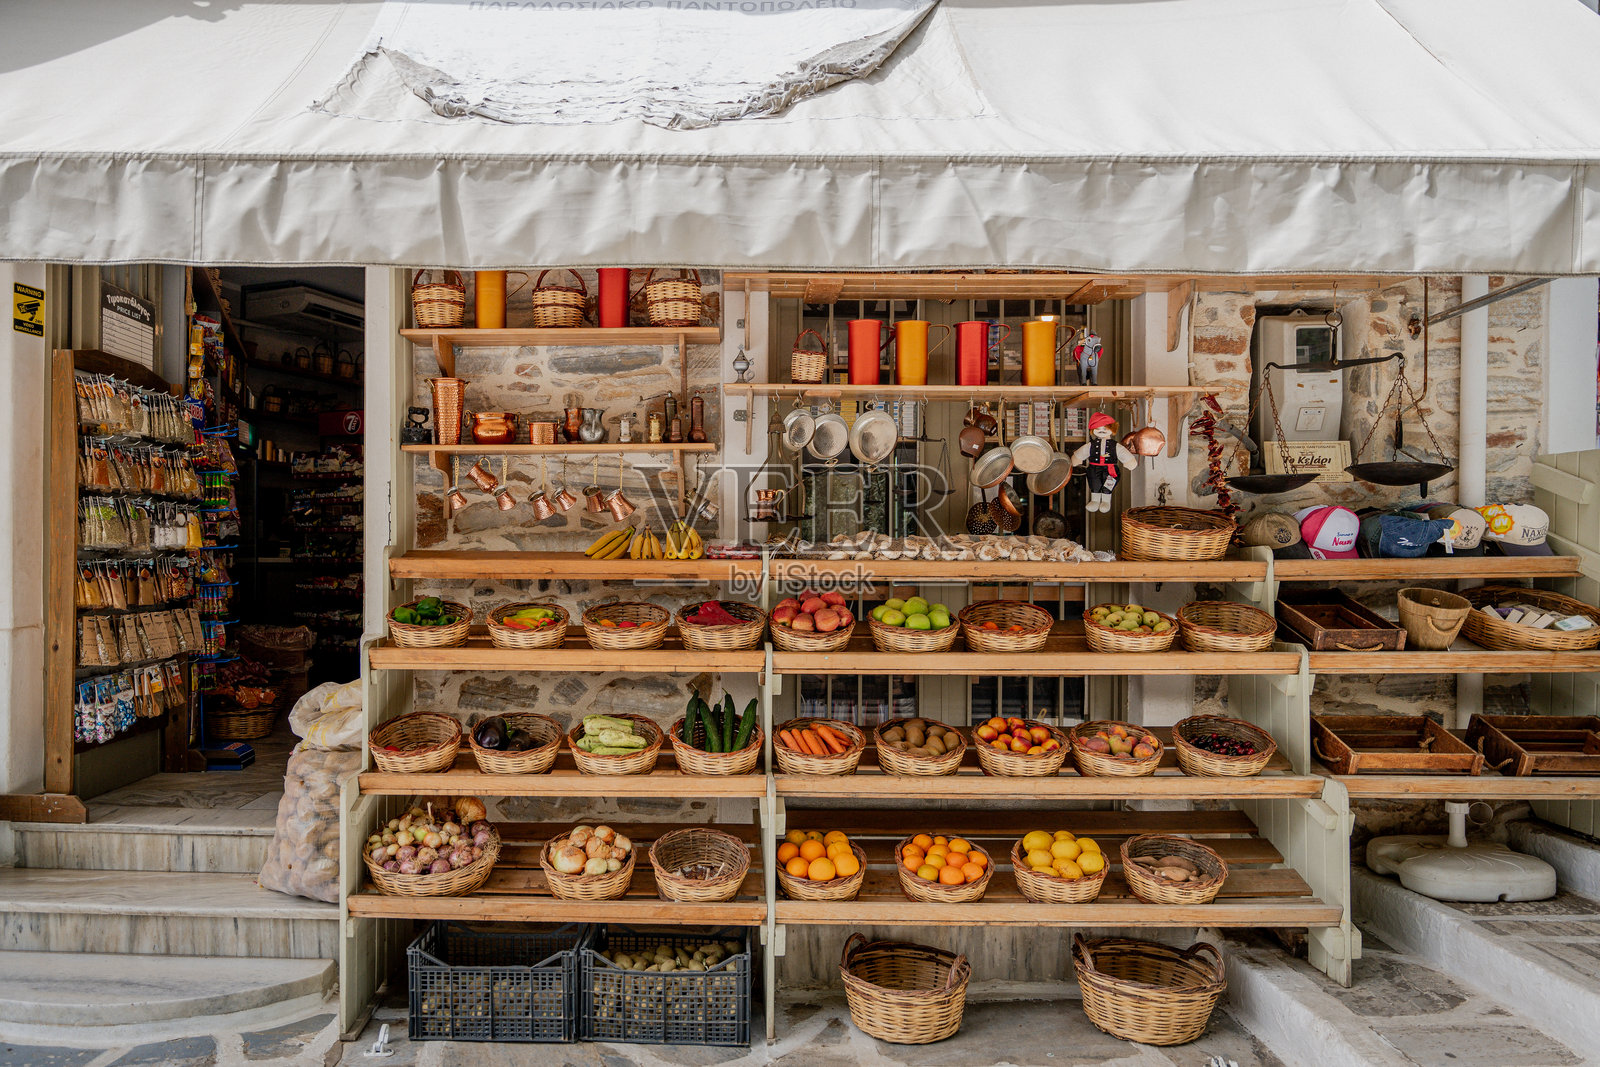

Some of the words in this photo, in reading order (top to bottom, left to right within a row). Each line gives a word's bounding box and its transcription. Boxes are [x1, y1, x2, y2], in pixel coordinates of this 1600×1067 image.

[468, 1, 654, 11] ΠΑΡΑΔΟΣΙΑΚΟ
[16, 285, 42, 298] WARNING
[116, 305, 131, 316] PRICE
[131, 311, 142, 320] LIST
[189, 403, 203, 421] ARIBO
[1494, 518, 1508, 526] UV
